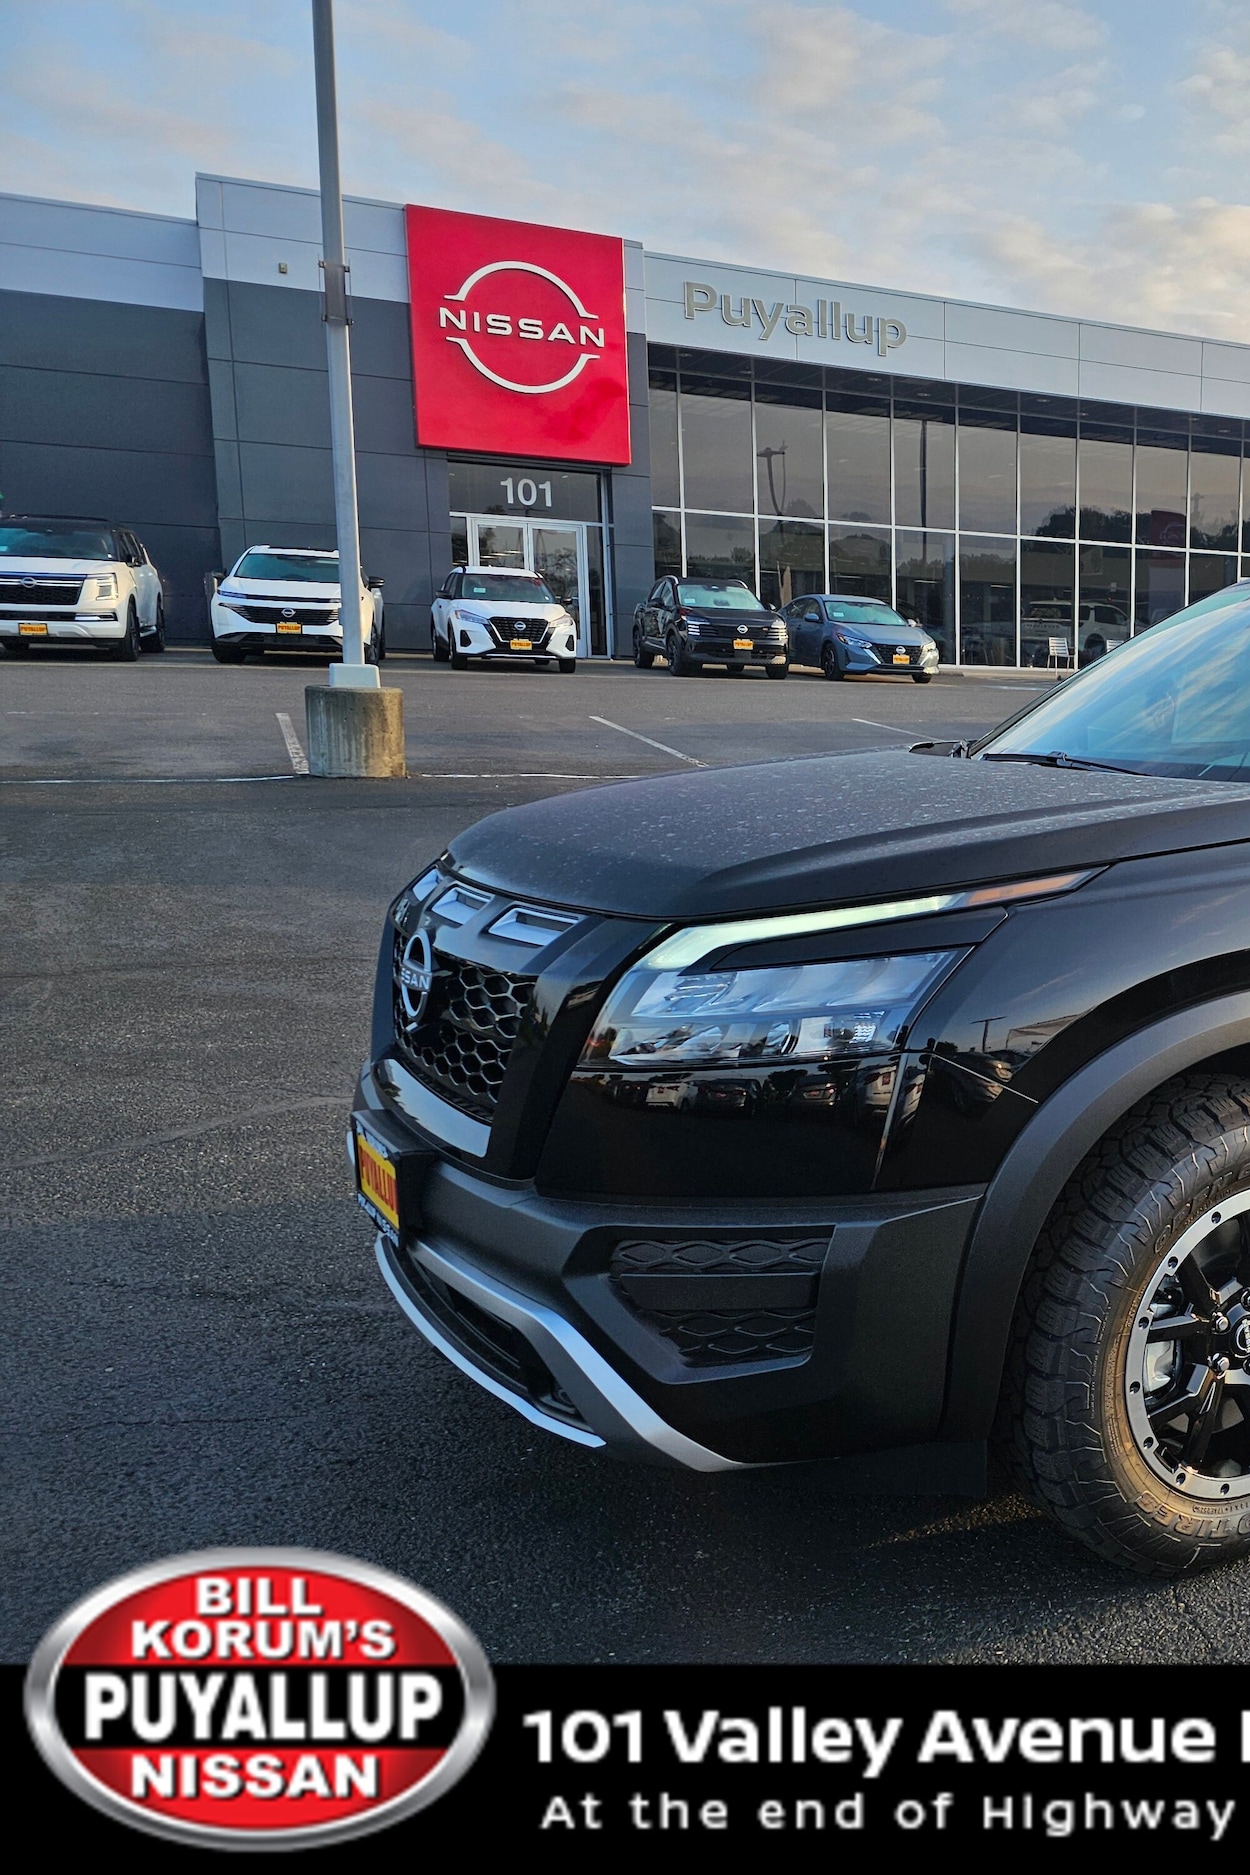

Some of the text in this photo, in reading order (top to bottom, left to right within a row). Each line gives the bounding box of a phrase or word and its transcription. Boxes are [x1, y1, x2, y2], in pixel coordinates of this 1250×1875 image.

[439, 305, 606, 349] NISSAN
[683, 280, 909, 357] Puyallup
[500, 477, 553, 508] 101
[1135, 1489, 1231, 1539] TIRES
